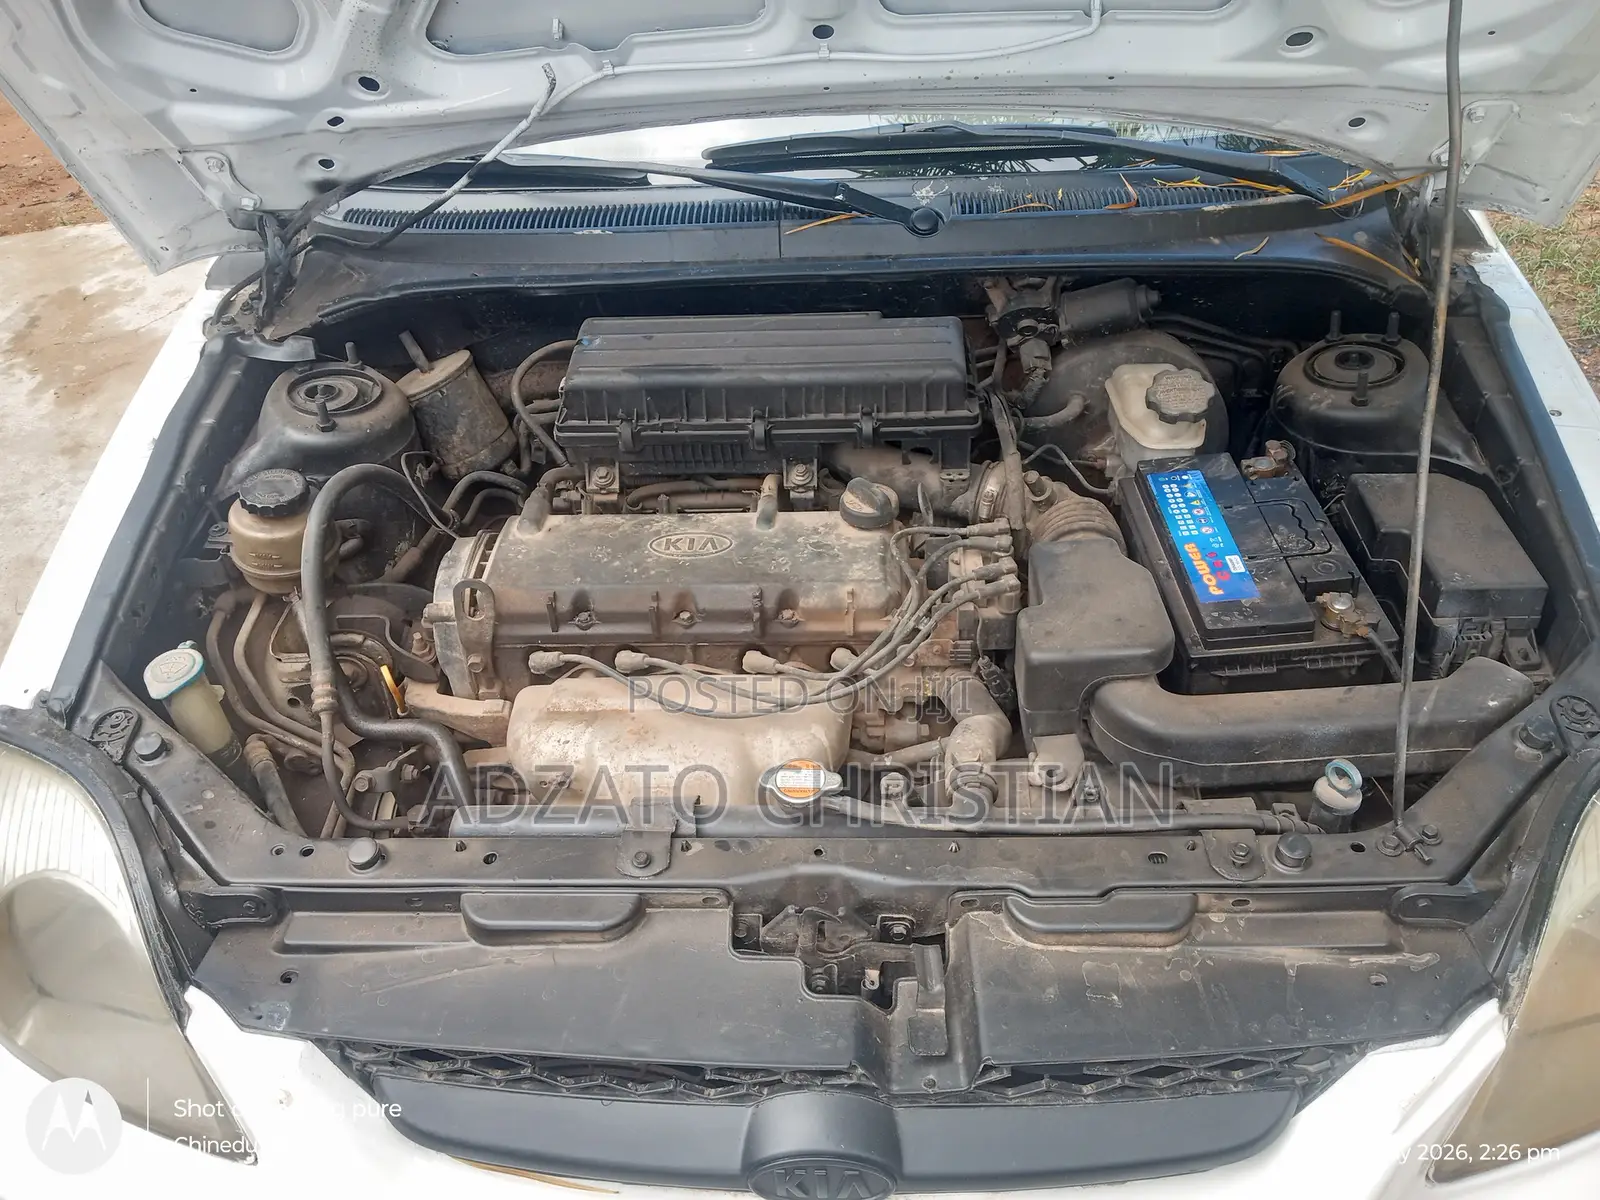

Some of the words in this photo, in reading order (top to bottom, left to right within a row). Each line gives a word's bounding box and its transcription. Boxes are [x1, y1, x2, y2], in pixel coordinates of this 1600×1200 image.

[664, 537, 718, 551] KIA
[1184, 542, 1225, 595] POWER
[774, 1169, 872, 1199] KIA
